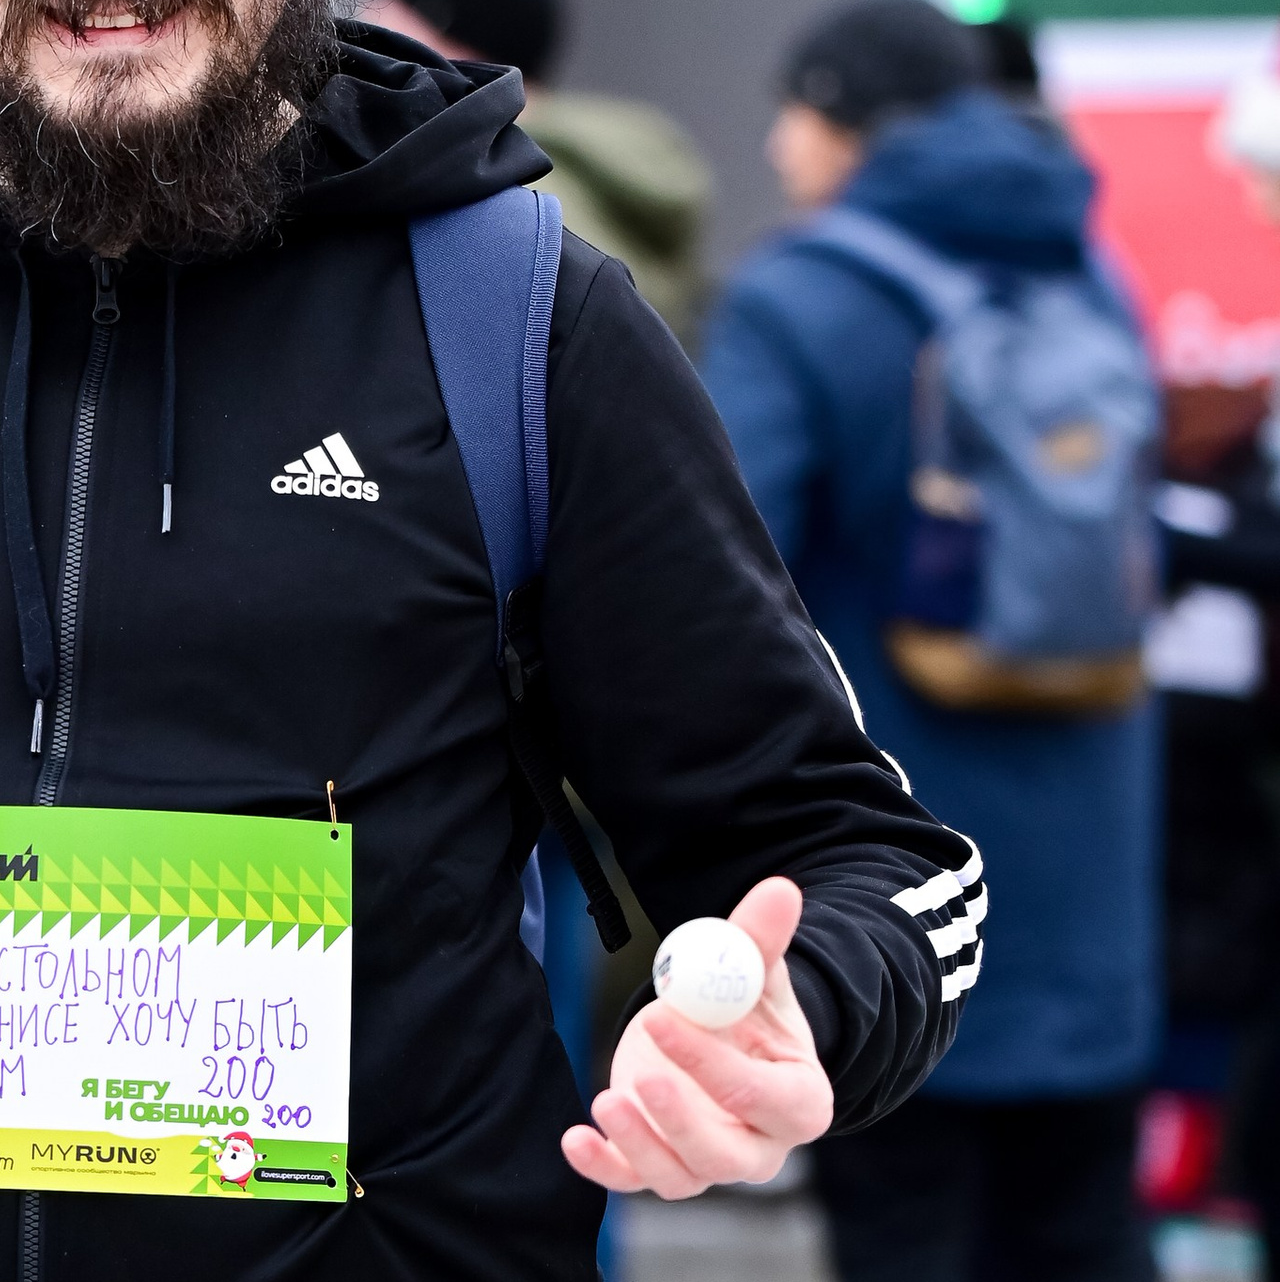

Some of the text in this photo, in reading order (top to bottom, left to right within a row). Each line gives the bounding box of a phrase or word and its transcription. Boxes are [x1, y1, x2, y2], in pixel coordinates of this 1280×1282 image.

[270, 471, 380, 503] adidas
[106, 998, 197, 1048] ХОЧУ
[212, 997, 309, 1054] БЫТЬ
[81, 1078, 171, 1101] Я БЕГУ
[198, 1055, 276, 1101] 200
[104, 1100, 250, 1128] И ОБЕЩАЮ
[261, 1104, 312, 1129] 200
[261, 1170, 325, 1180] ilovesupersport.com
